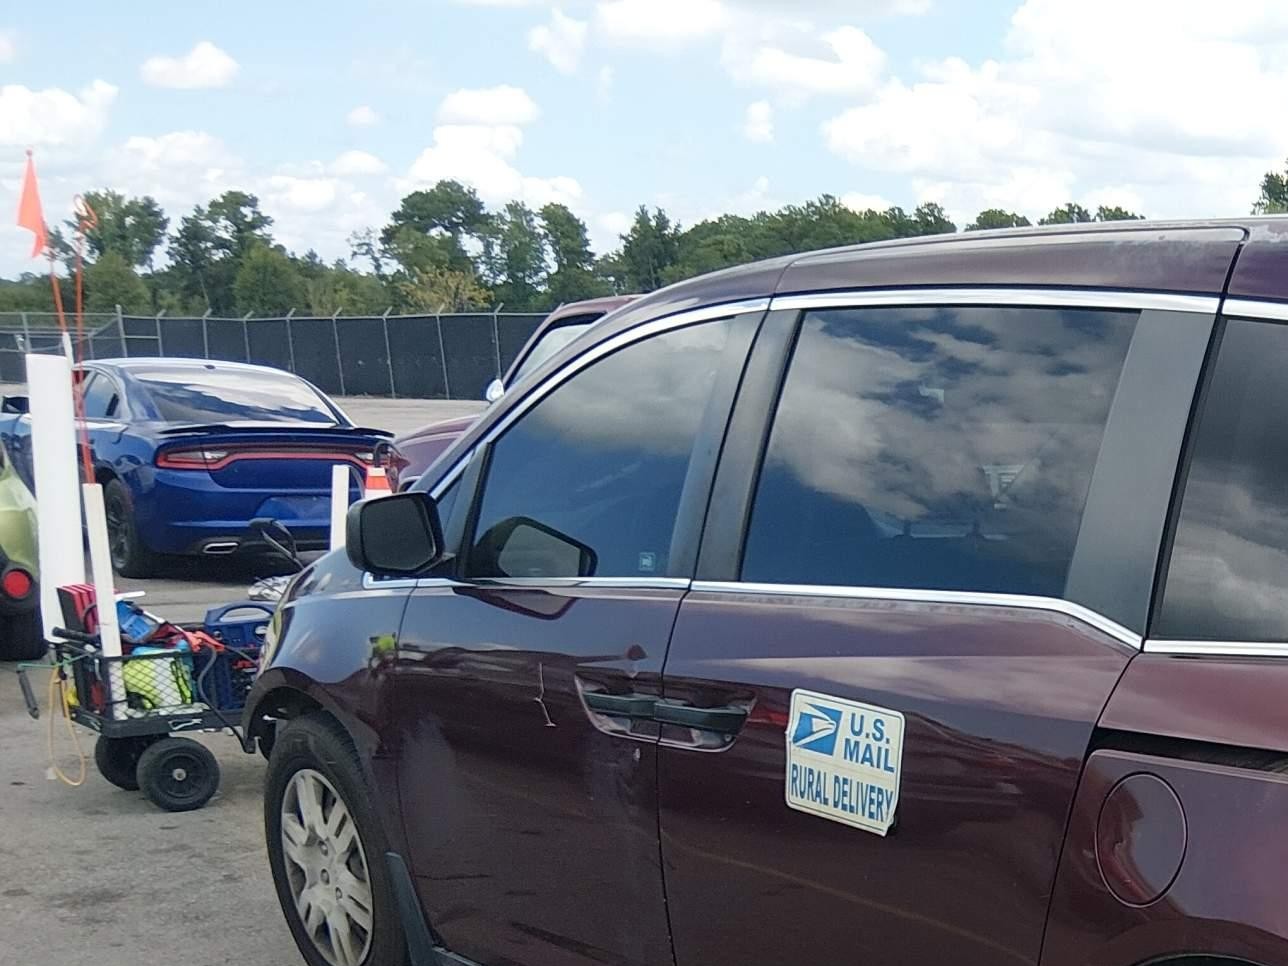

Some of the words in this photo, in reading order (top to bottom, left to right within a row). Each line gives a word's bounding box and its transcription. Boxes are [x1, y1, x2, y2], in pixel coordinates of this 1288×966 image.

[850, 712, 890, 744] U.S.
[843, 737, 895, 774] MAIL
[790, 763, 830, 807] RURAL
[832, 775, 894, 822] DELIVERY
